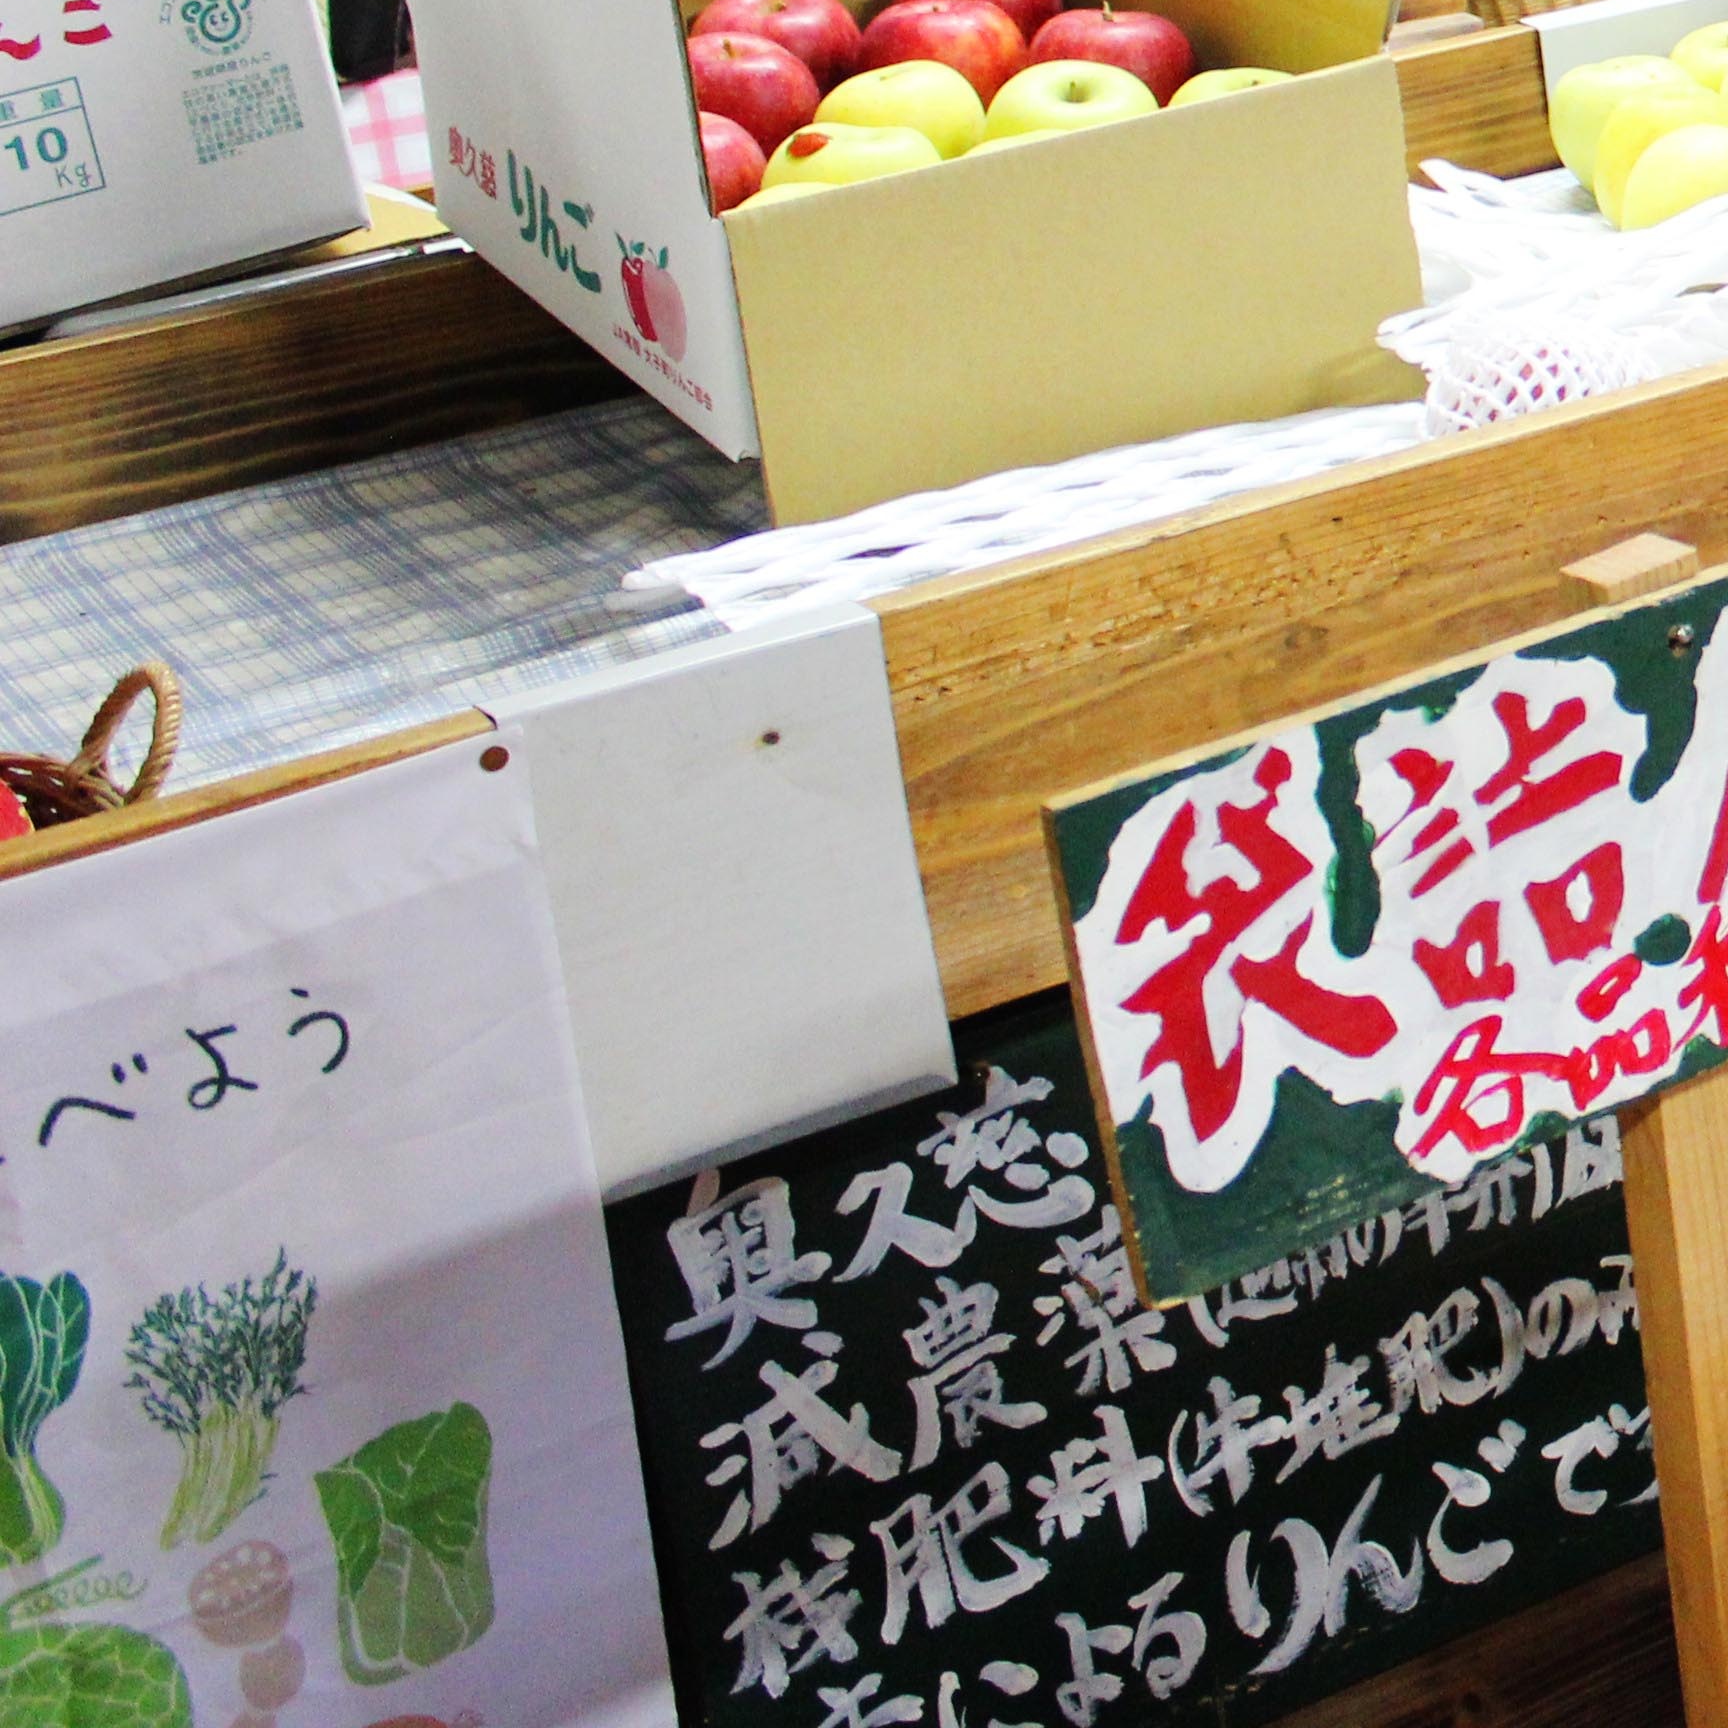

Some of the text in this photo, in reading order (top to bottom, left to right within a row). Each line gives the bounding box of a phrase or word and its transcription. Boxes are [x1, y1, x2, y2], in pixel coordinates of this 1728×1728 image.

[3, 126, 92, 189] 10 Kg
[448, 126, 603, 294] 奥久慈 りんご
[1117, 690, 1626, 1146] 袋詰
[0, 985, 353, 1167] べよう
[665, 1065, 1094, 1370] 奥久慈
